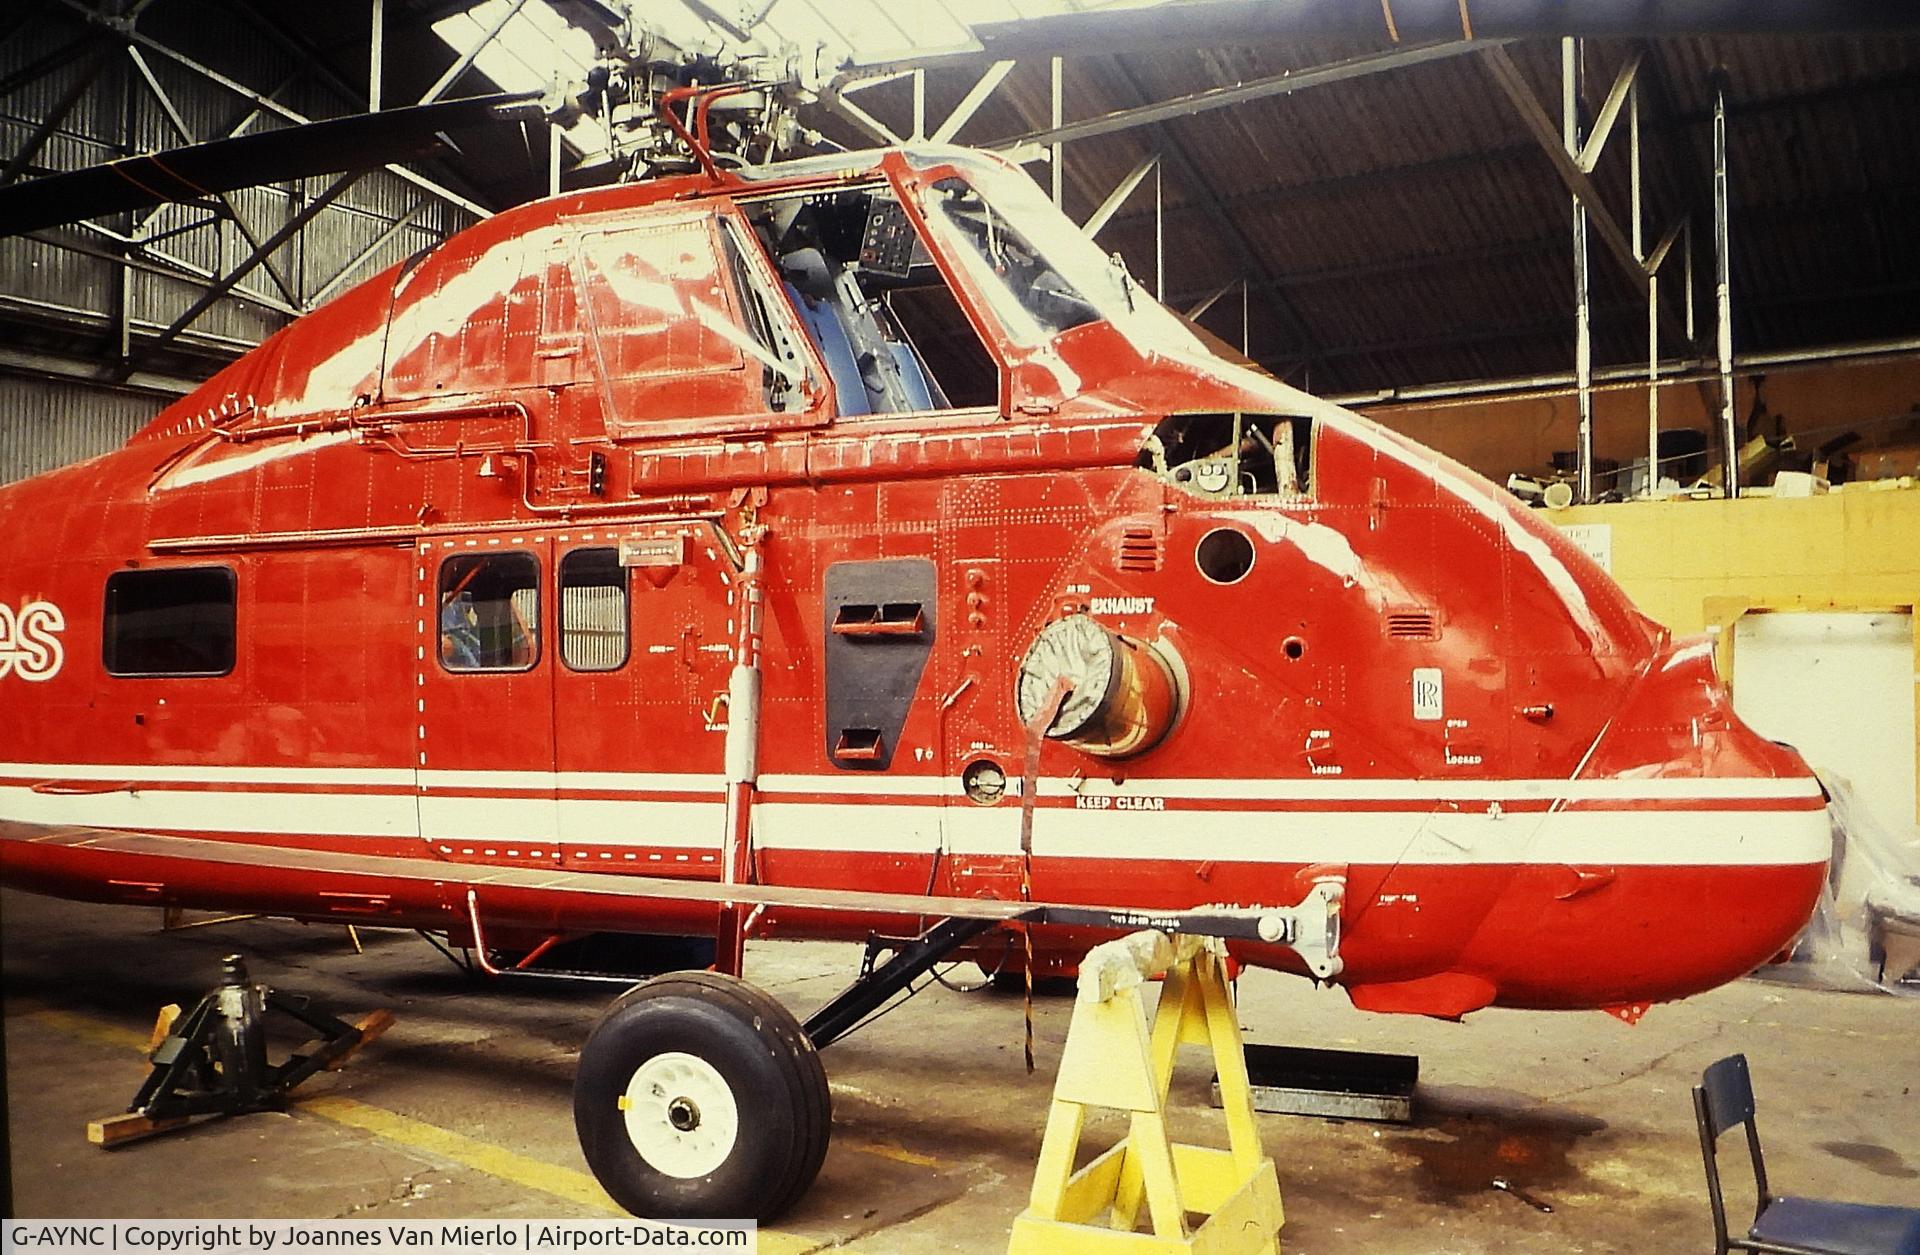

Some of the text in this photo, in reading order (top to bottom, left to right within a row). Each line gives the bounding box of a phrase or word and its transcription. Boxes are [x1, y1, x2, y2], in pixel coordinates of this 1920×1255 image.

[1091, 597, 1155, 615] EXHAUST
[1076, 796, 1165, 811] KEEP CLEAR
